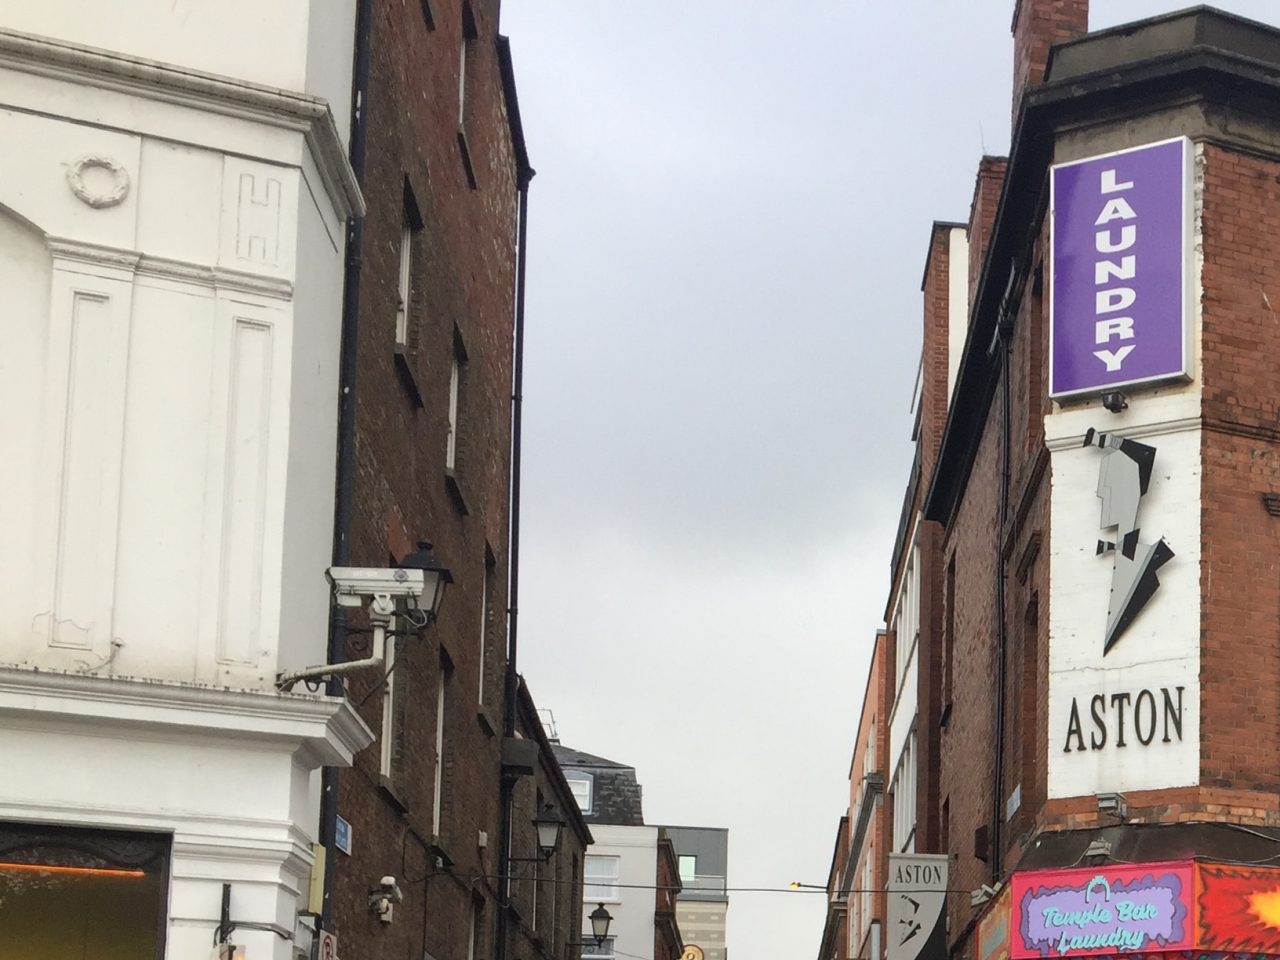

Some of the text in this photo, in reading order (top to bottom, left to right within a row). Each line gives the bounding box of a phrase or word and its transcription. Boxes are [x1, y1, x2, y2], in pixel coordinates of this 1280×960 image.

[1093, 169, 1137, 372] LAUNDRY
[1063, 686, 1185, 753] ASTON
[895, 864, 942, 884] ASTON
[1042, 900, 1158, 929] Temple Bar
[1057, 927, 1144, 956] Laundry
